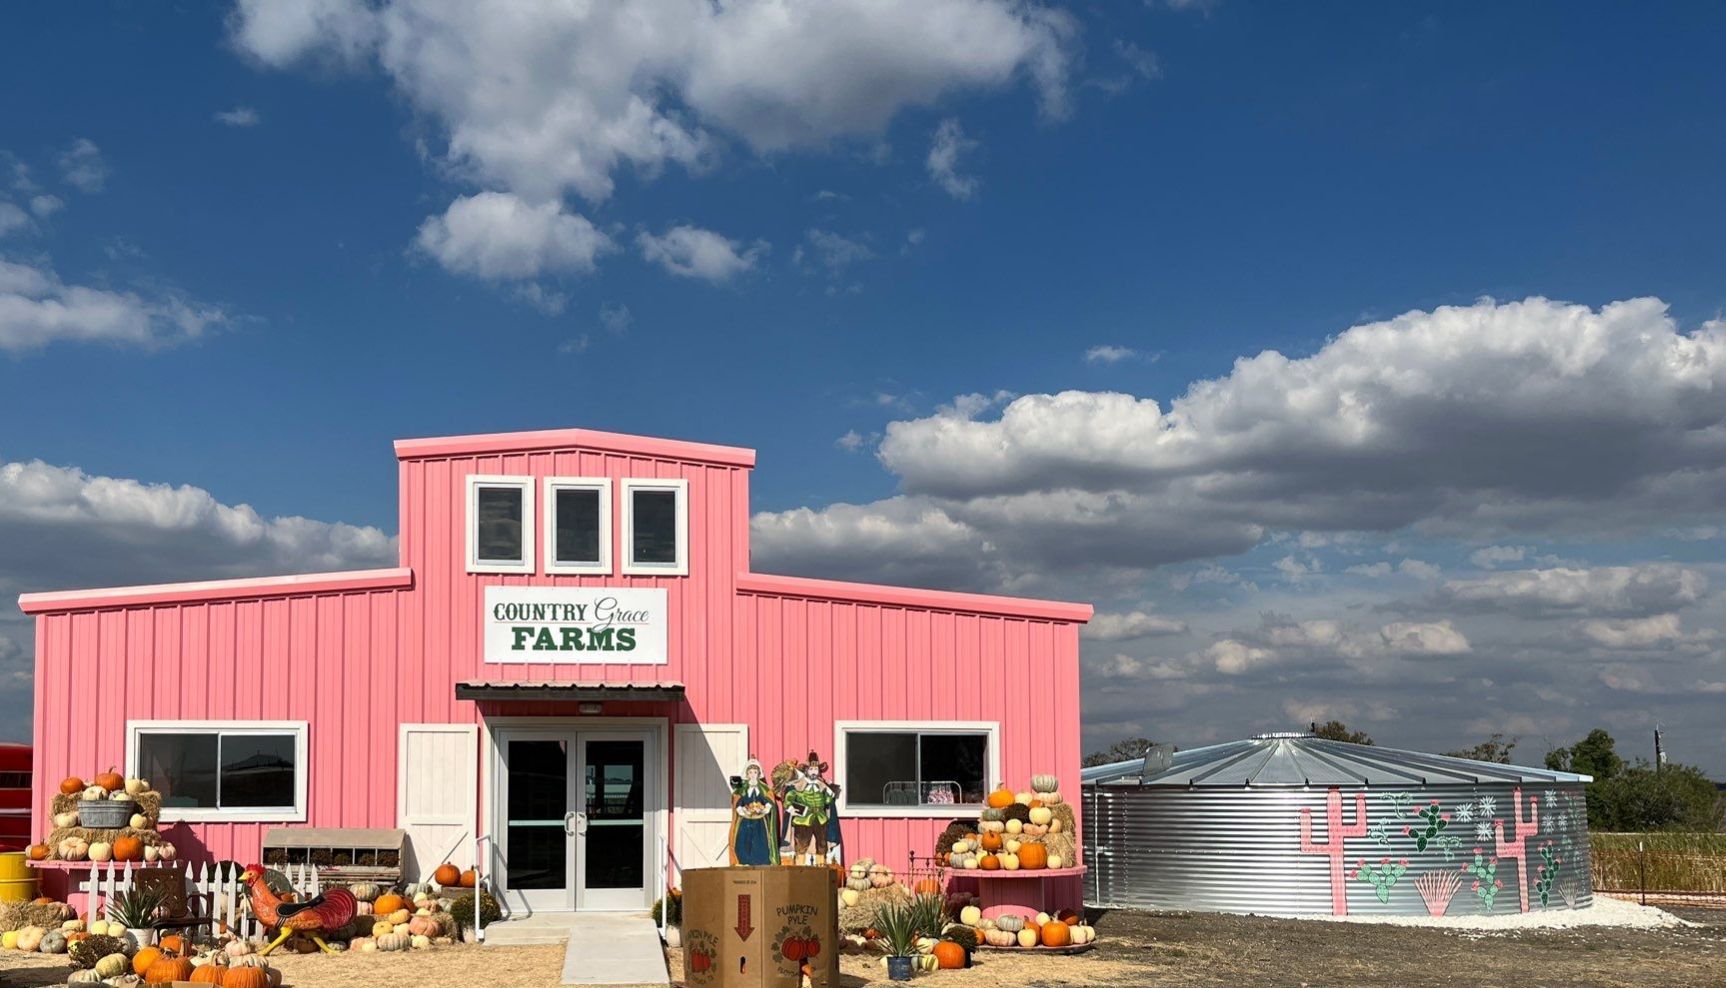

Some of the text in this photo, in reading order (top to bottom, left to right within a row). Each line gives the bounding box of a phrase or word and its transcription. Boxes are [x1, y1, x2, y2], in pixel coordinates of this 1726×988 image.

[493, 596, 650, 633] COUNTRY Grace
[511, 626, 637, 651] FARMS
[776, 903, 819, 917] PUMPKIN
[787, 915, 809, 925] PYLE
